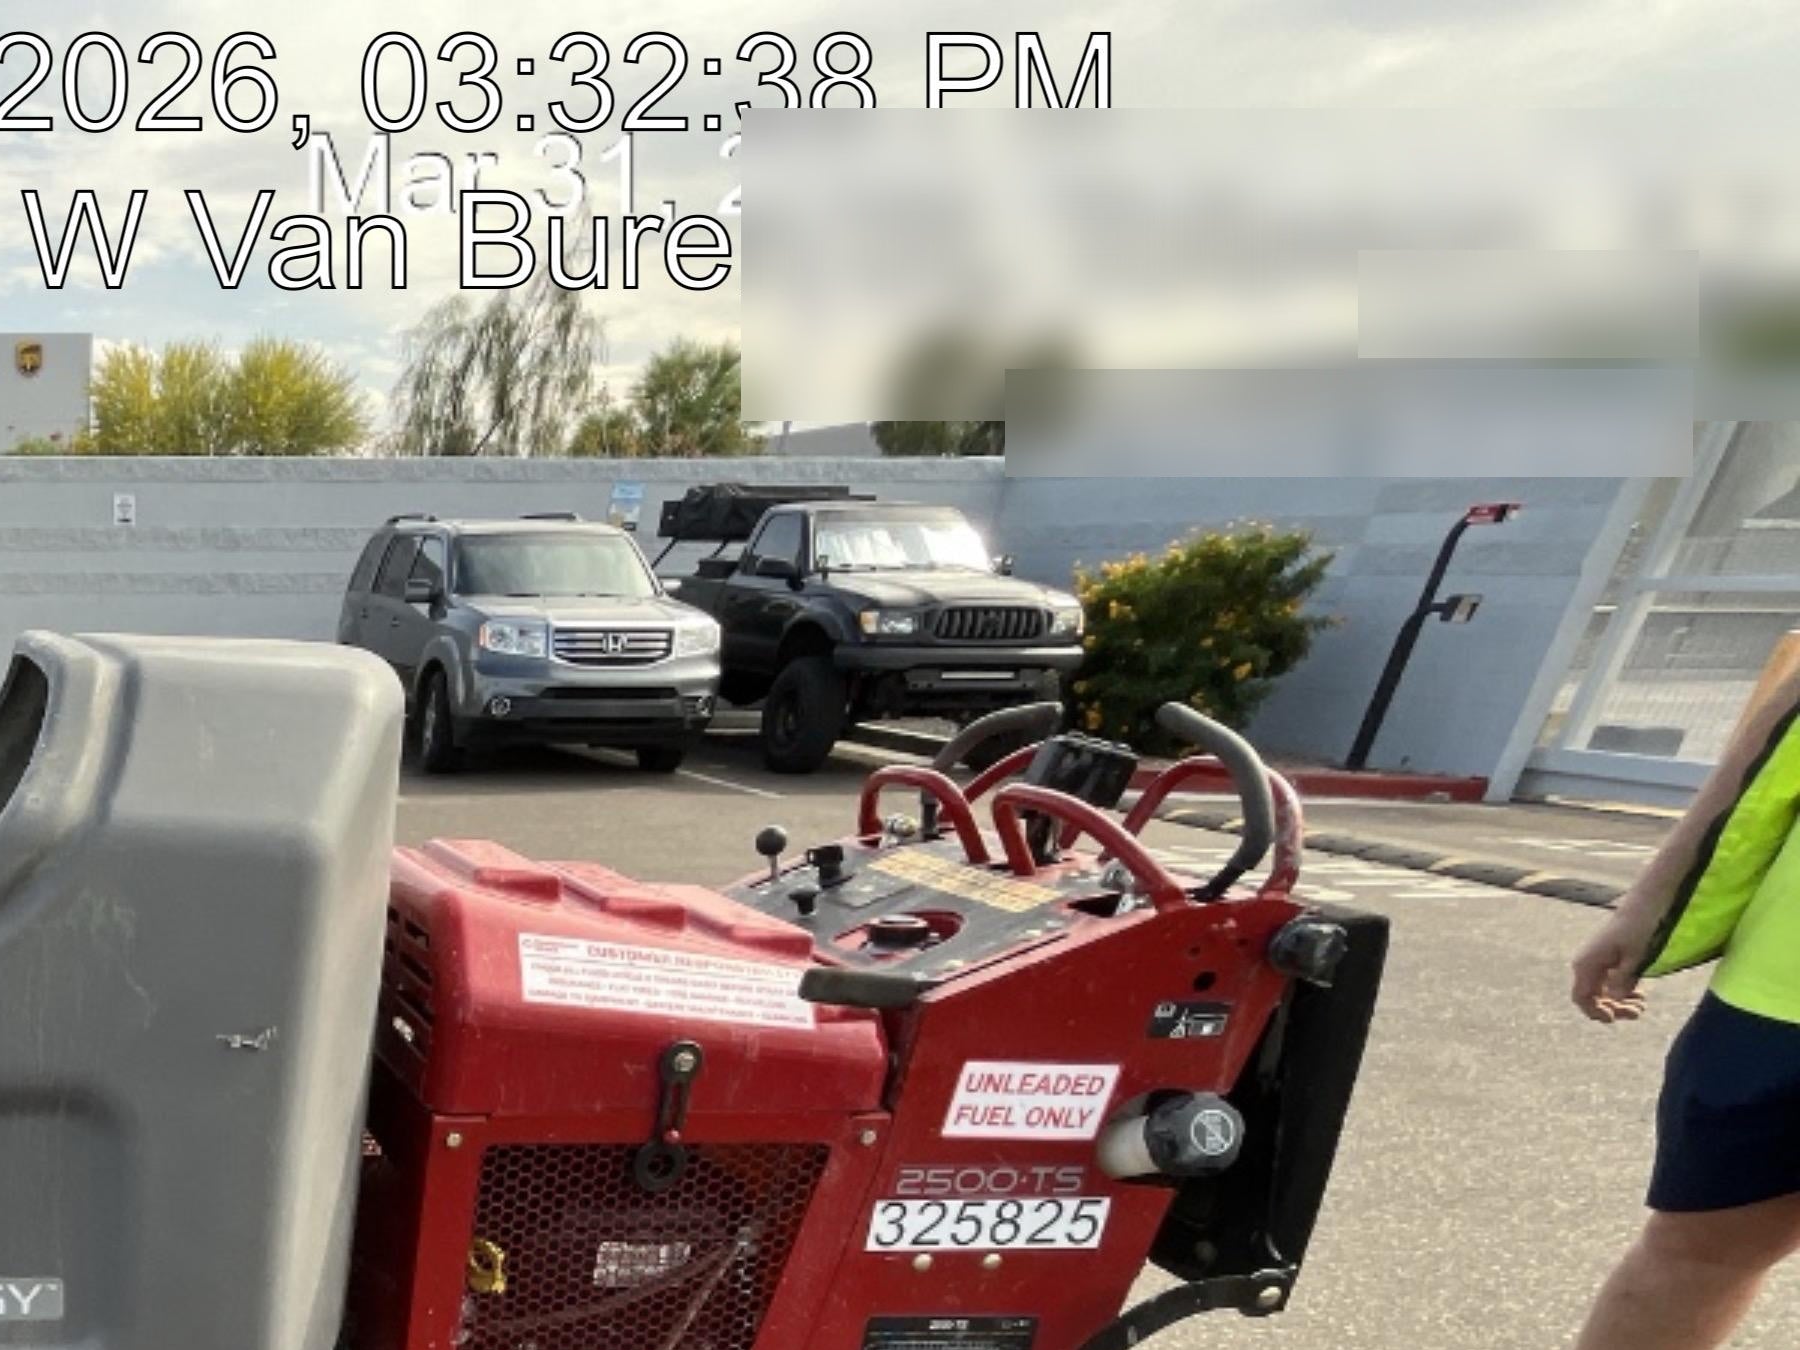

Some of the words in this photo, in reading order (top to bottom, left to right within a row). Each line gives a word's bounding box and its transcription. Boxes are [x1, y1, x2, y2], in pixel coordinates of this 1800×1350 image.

[964, 1073, 1106, 1096] UNLEADED
[952, 1105, 1017, 1126] FUEL
[1025, 1106, 1096, 1129] ONLY
[874, 1199, 1104, 1246] 325825
